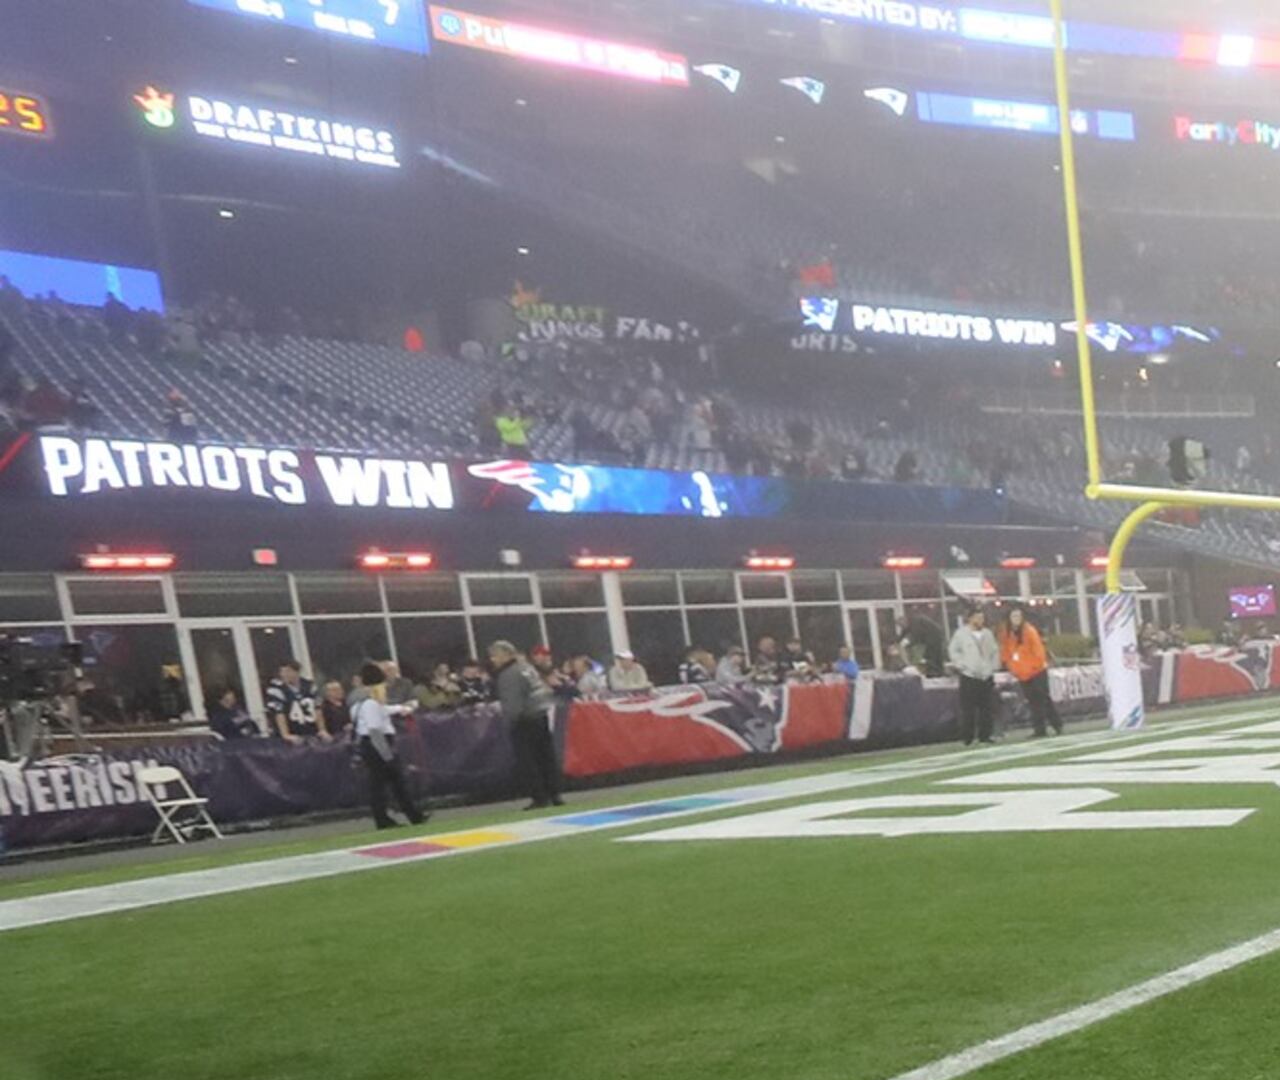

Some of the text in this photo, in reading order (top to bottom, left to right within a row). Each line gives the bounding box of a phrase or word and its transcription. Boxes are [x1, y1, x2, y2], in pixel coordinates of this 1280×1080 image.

[187, 96, 395, 153] DRAFTKINGS
[852, 305, 1056, 346] PATRIOTS WIN
[40, 435, 454, 509] PATRIOTS WIN
